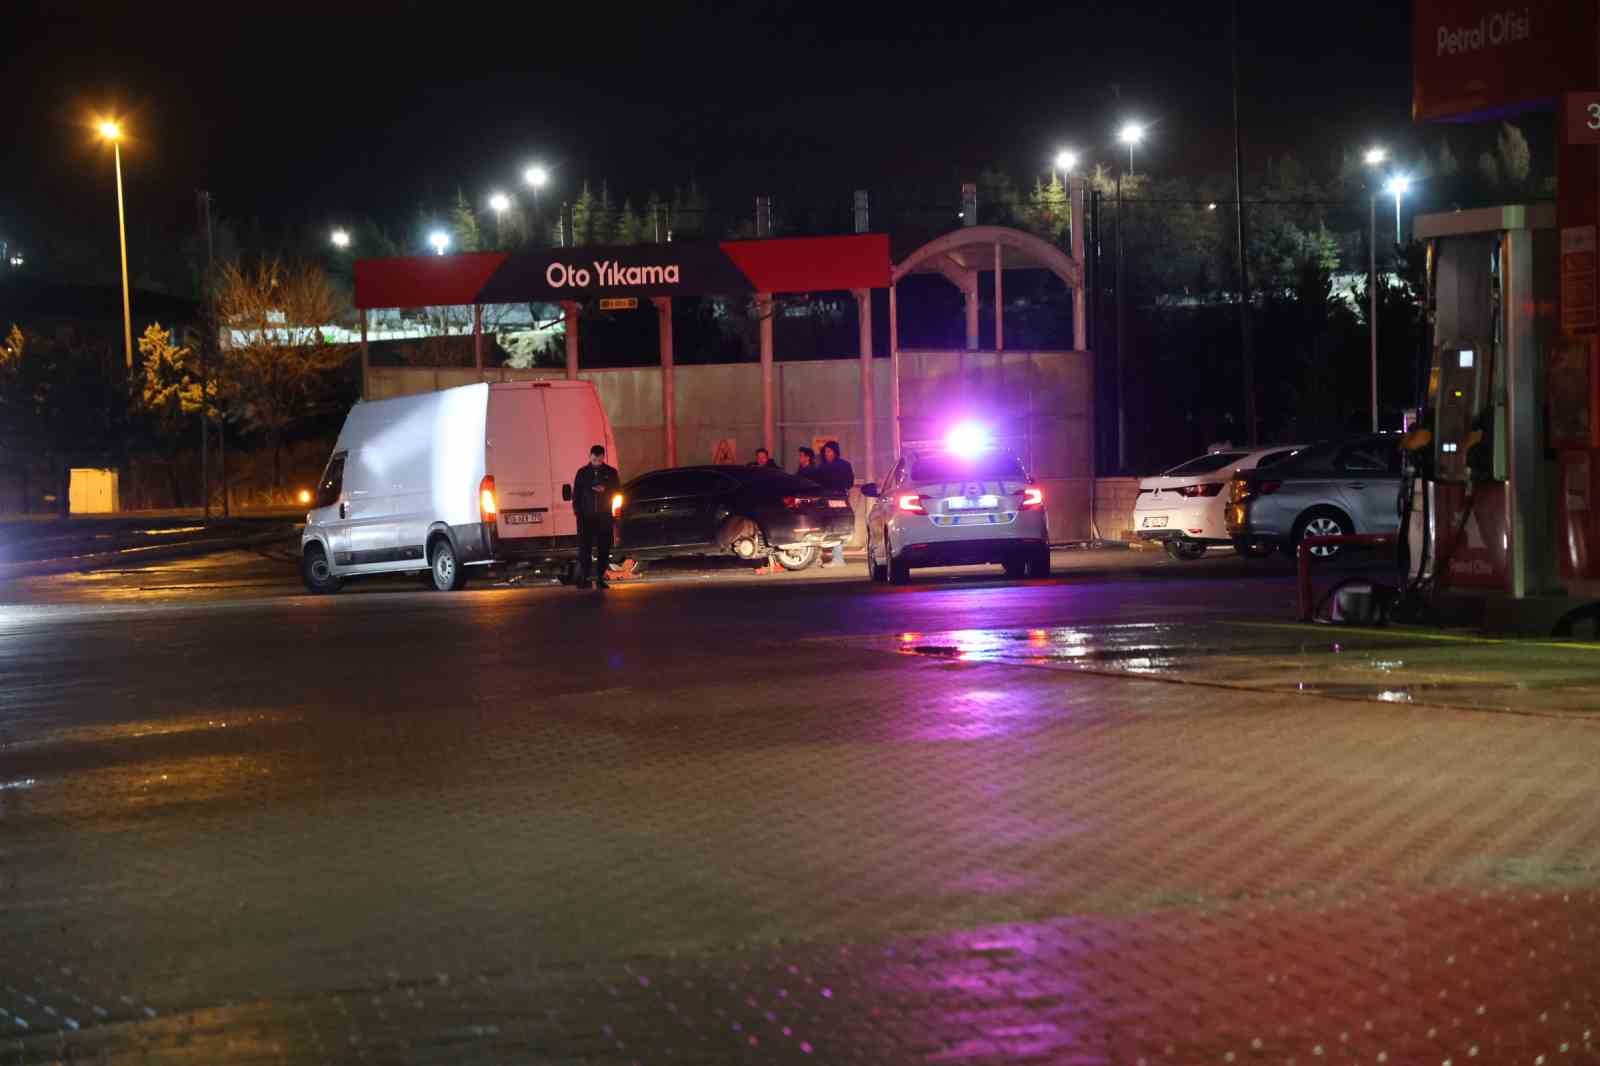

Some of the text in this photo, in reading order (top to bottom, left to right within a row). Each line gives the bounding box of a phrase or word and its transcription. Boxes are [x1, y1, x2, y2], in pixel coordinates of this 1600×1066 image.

[1436, 8, 1529, 56] Petrol Ofisi
[546, 262, 591, 288] Oto
